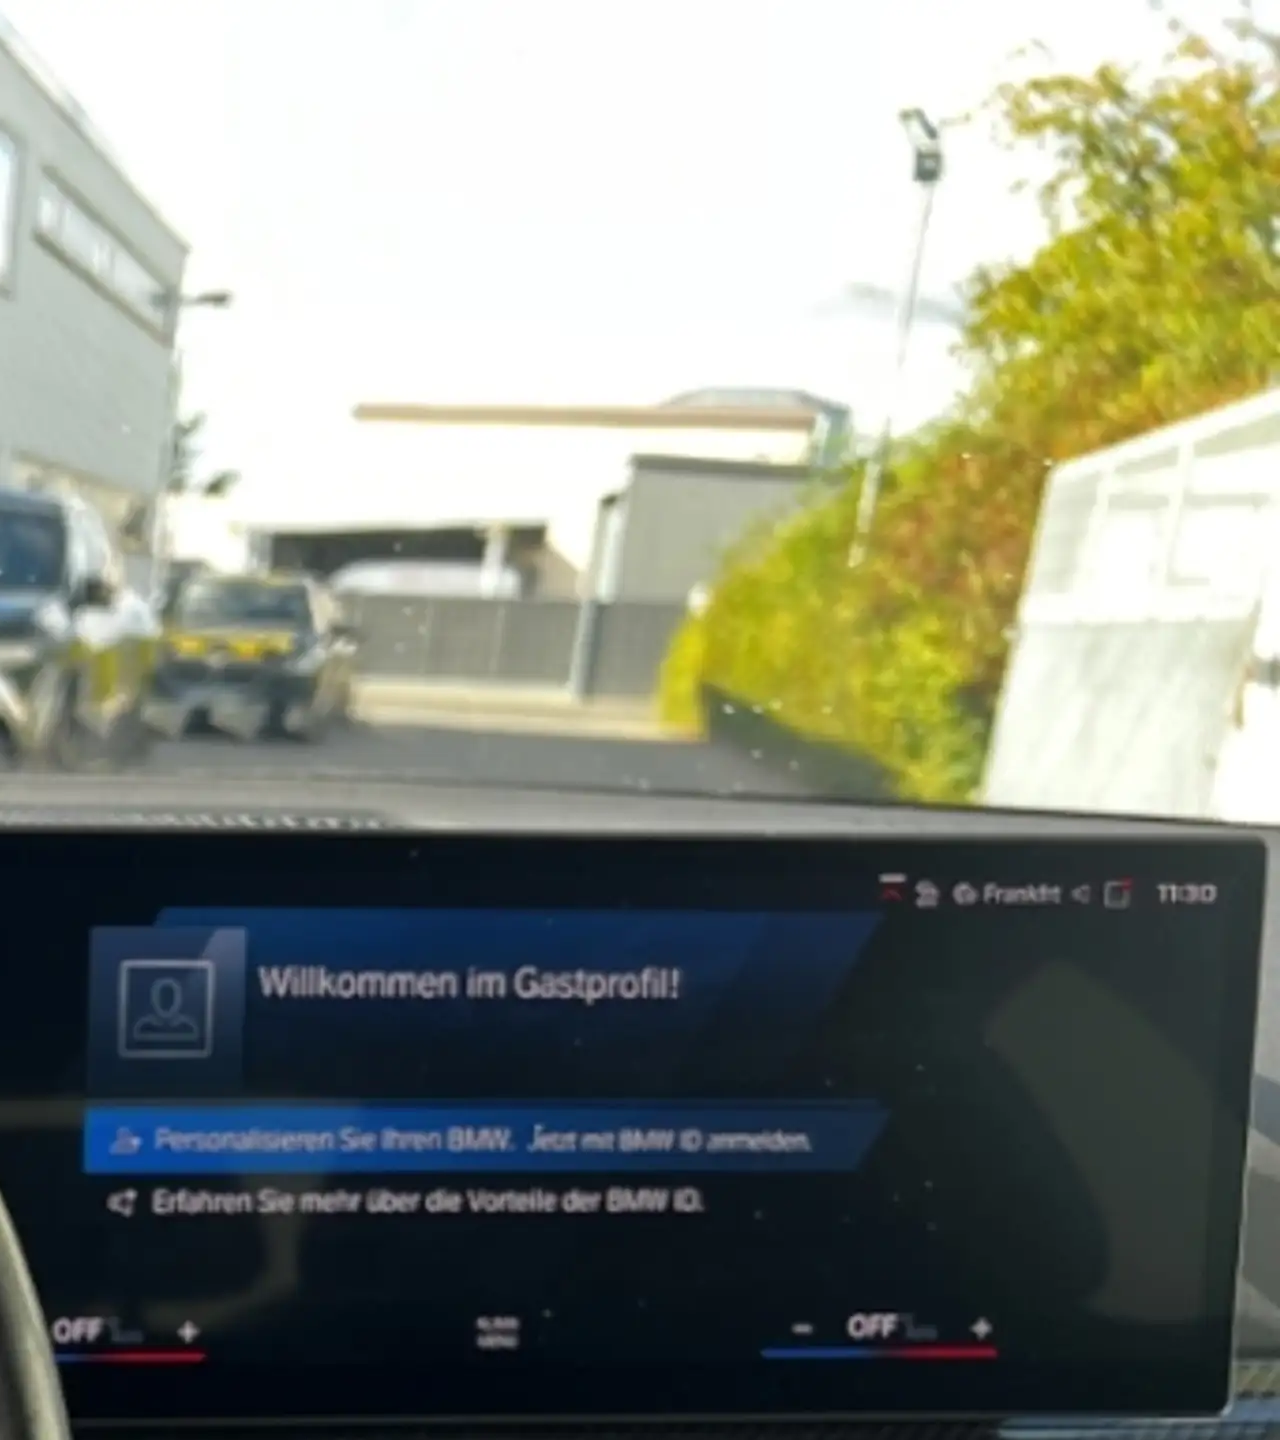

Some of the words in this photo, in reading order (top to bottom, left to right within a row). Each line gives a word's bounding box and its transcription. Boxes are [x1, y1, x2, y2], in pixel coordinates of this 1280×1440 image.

[257, 965, 457, 999] Willkommen
[466, 967, 506, 999] im
[513, 965, 681, 1006] Gastprofil!
[154, 1127, 334, 1152] Personalisieren
[339, 1127, 376, 1151] Sie
[381, 1127, 440, 1151] Ihren
[618, 1129, 676, 1152] BMW
[150, 1188, 254, 1215] Erfahren
[256, 1188, 294, 1215] Sie
[299, 1189, 362, 1214] mehr
[365, 1188, 421, 1214] über
[424, 1188, 461, 1214] die
[465, 1188, 558, 1214] Vorteile
[561, 1190, 602, 1214] der
[606, 1186, 670, 1214] BMW
[53, 1316, 103, 1344] OFF
[846, 1313, 899, 1339] OFF
